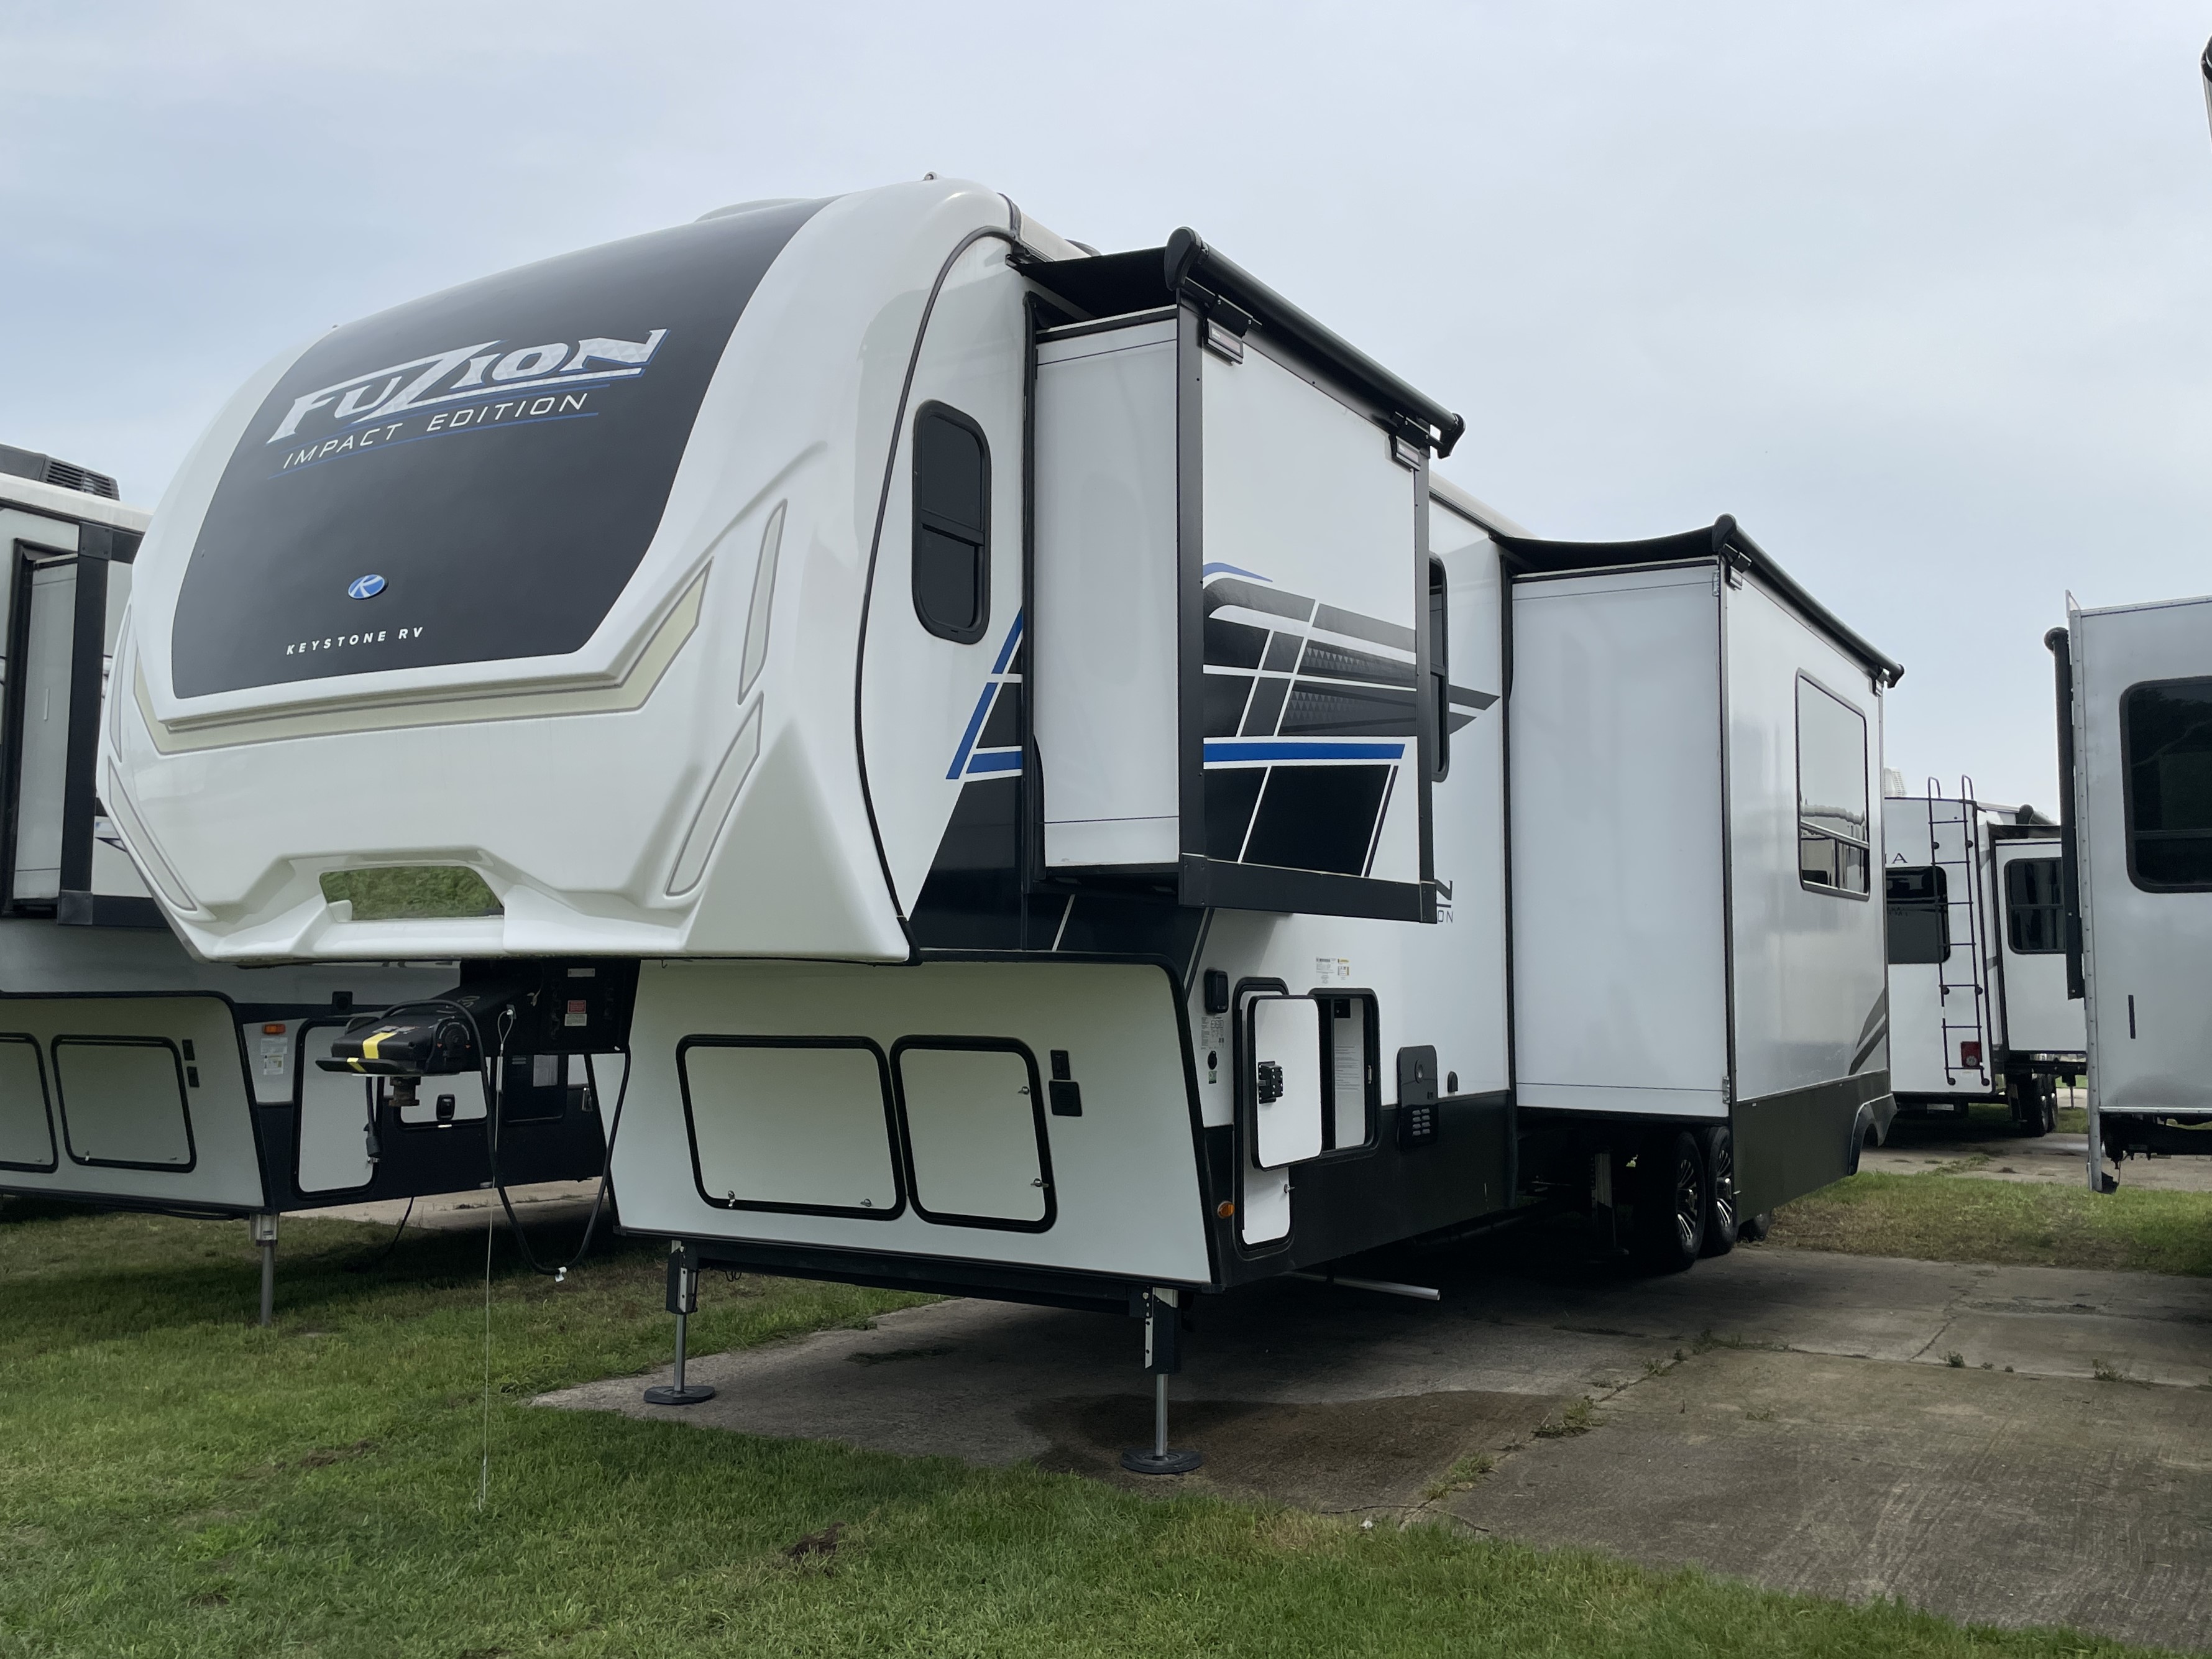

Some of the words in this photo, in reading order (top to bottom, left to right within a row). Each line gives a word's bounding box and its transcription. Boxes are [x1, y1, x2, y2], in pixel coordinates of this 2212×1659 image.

[266, 328, 668, 444] FUZION
[283, 423, 403, 469] IMPACT
[426, 393, 588, 433] EDITION
[287, 630, 387, 655] KEYSTONE
[398, 627, 424, 640] RV
